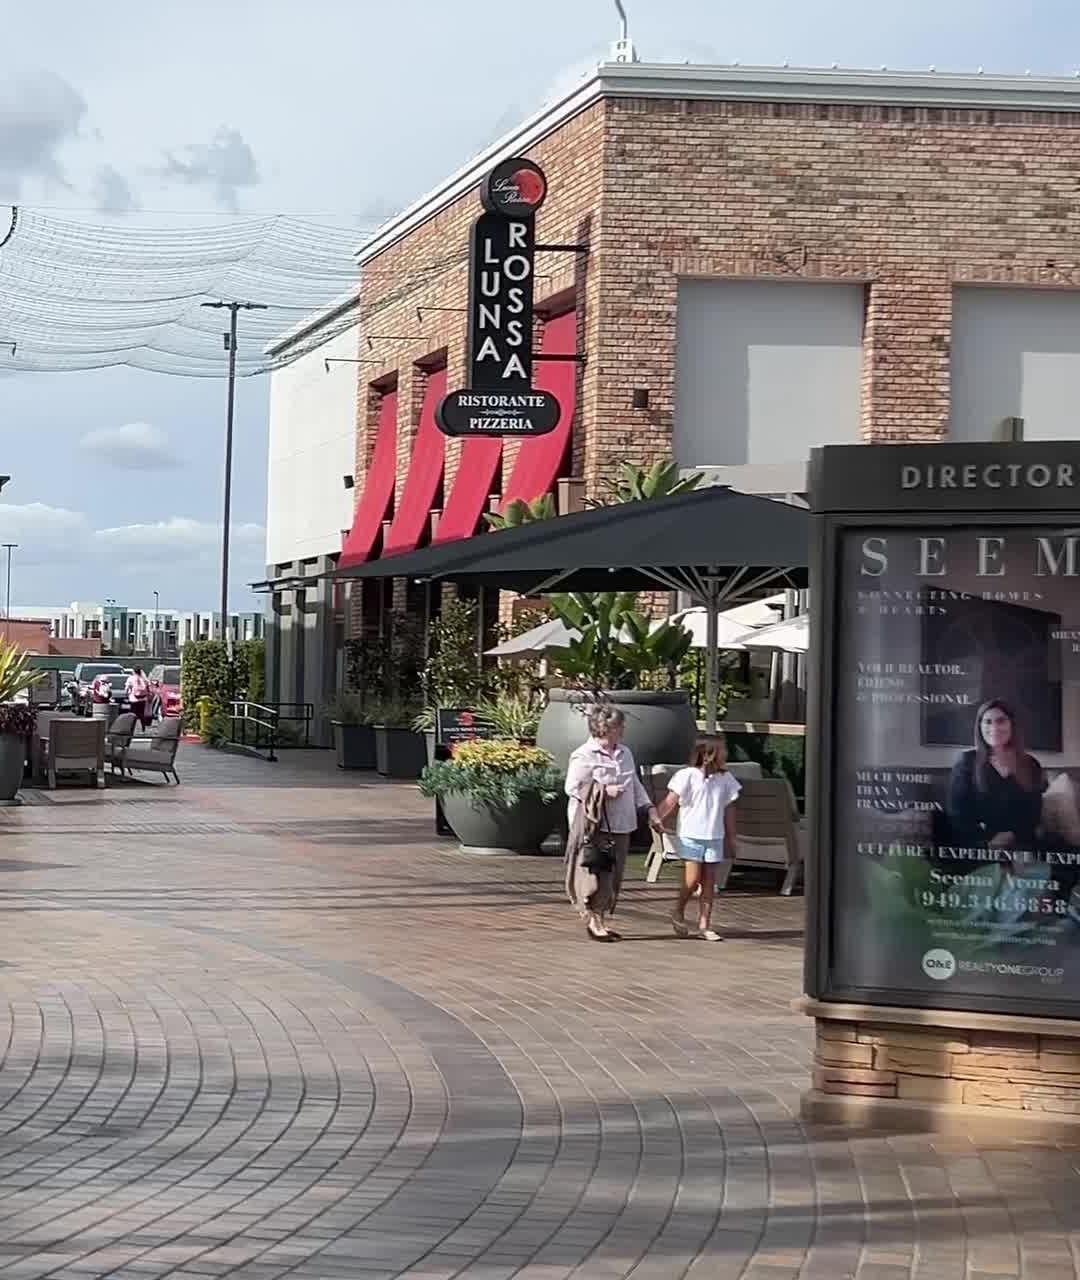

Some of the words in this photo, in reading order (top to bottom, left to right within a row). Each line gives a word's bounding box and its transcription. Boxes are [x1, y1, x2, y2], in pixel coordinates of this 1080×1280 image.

[476, 238, 501, 362] LUNA
[501, 222, 531, 379] ROSSA
[457, 394, 546, 408] RISTORANTE
[468, 417, 535, 430] PIZZERIA
[895, 773, 931, 785] MORE
[856, 799, 945, 812] TRANSACTION
[857, 840, 923, 858] CULTURE
[937, 846, 1032, 865] EXPERIENCE
[929, 869, 994, 888] Seema
